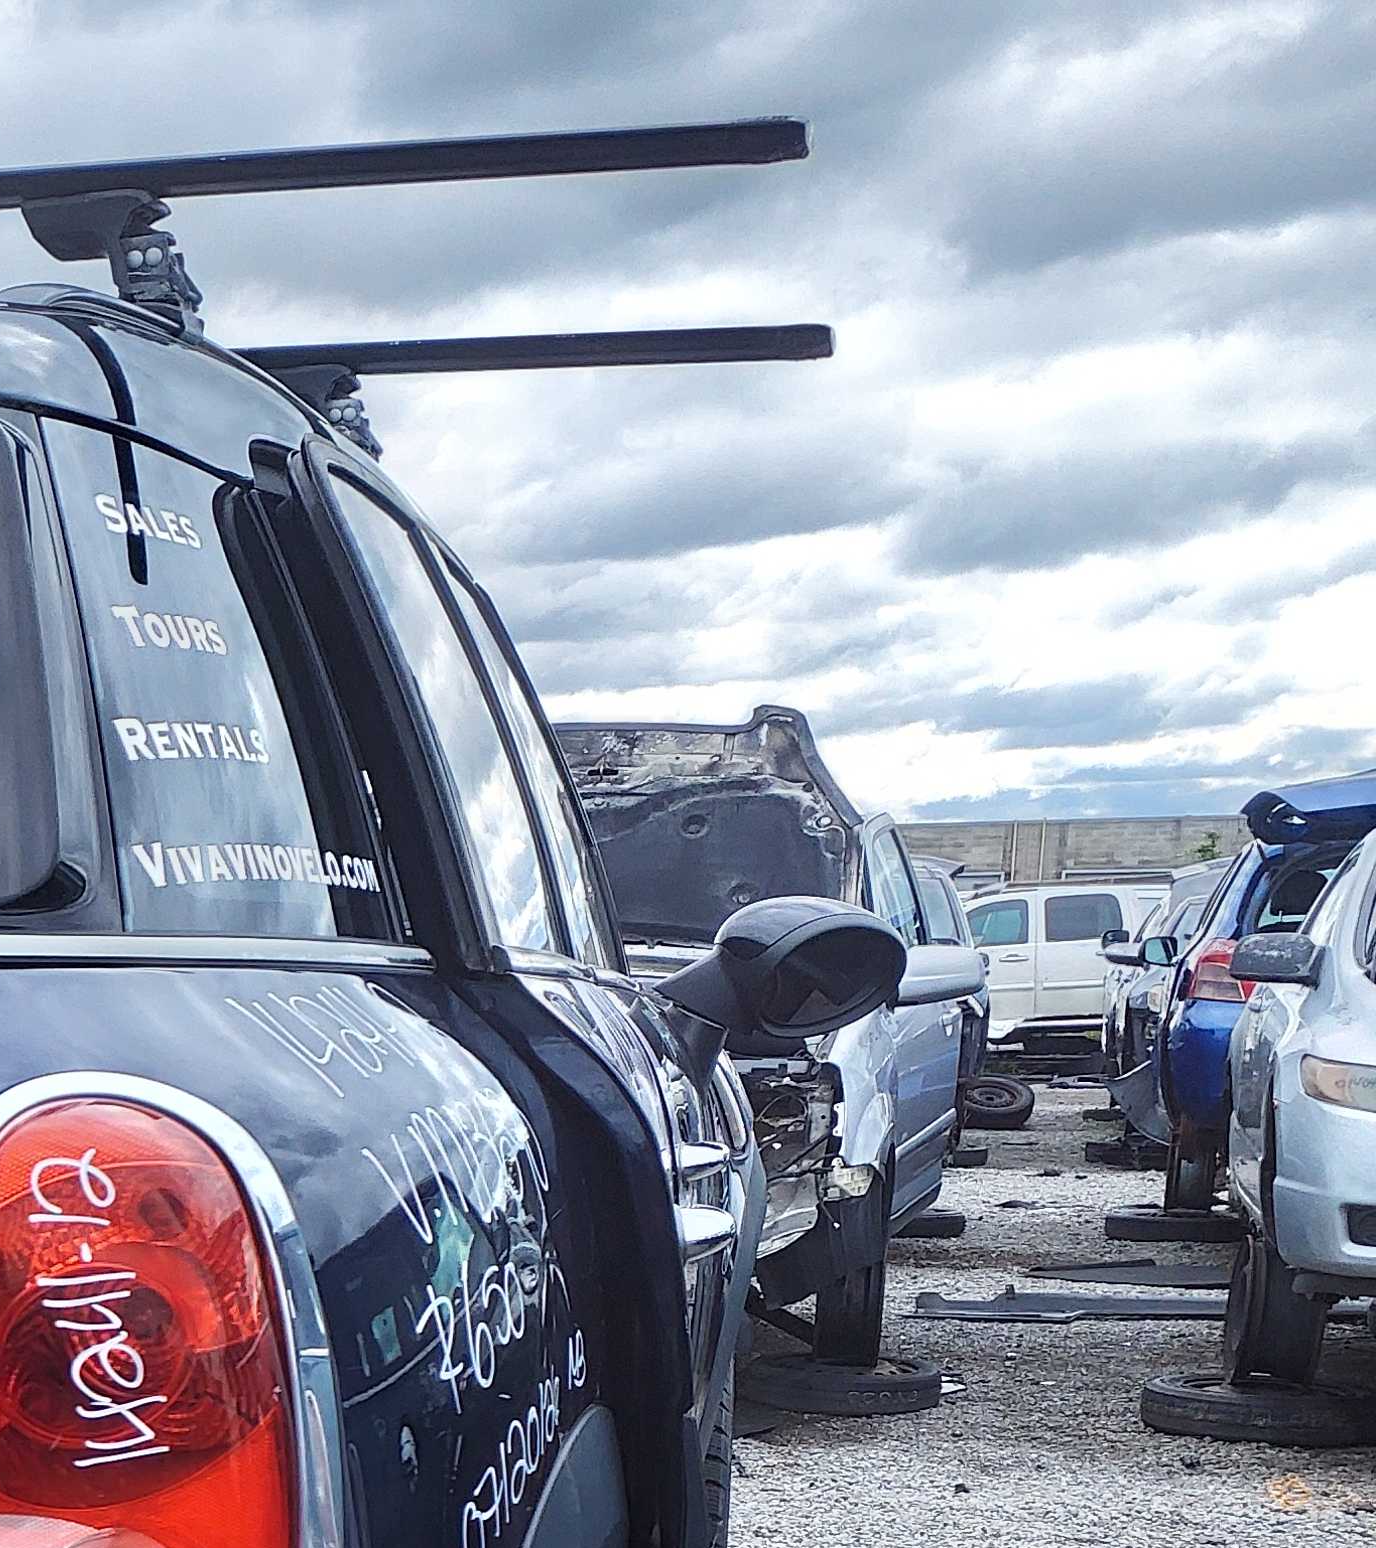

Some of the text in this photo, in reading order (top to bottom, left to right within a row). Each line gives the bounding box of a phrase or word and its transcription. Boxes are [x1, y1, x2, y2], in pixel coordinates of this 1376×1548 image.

[94, 494, 202, 550] SALES
[110, 604, 229, 657] TOURS
[112, 717, 271, 766] RENTALS
[28, 1147, 172, 1468] 14241-12
